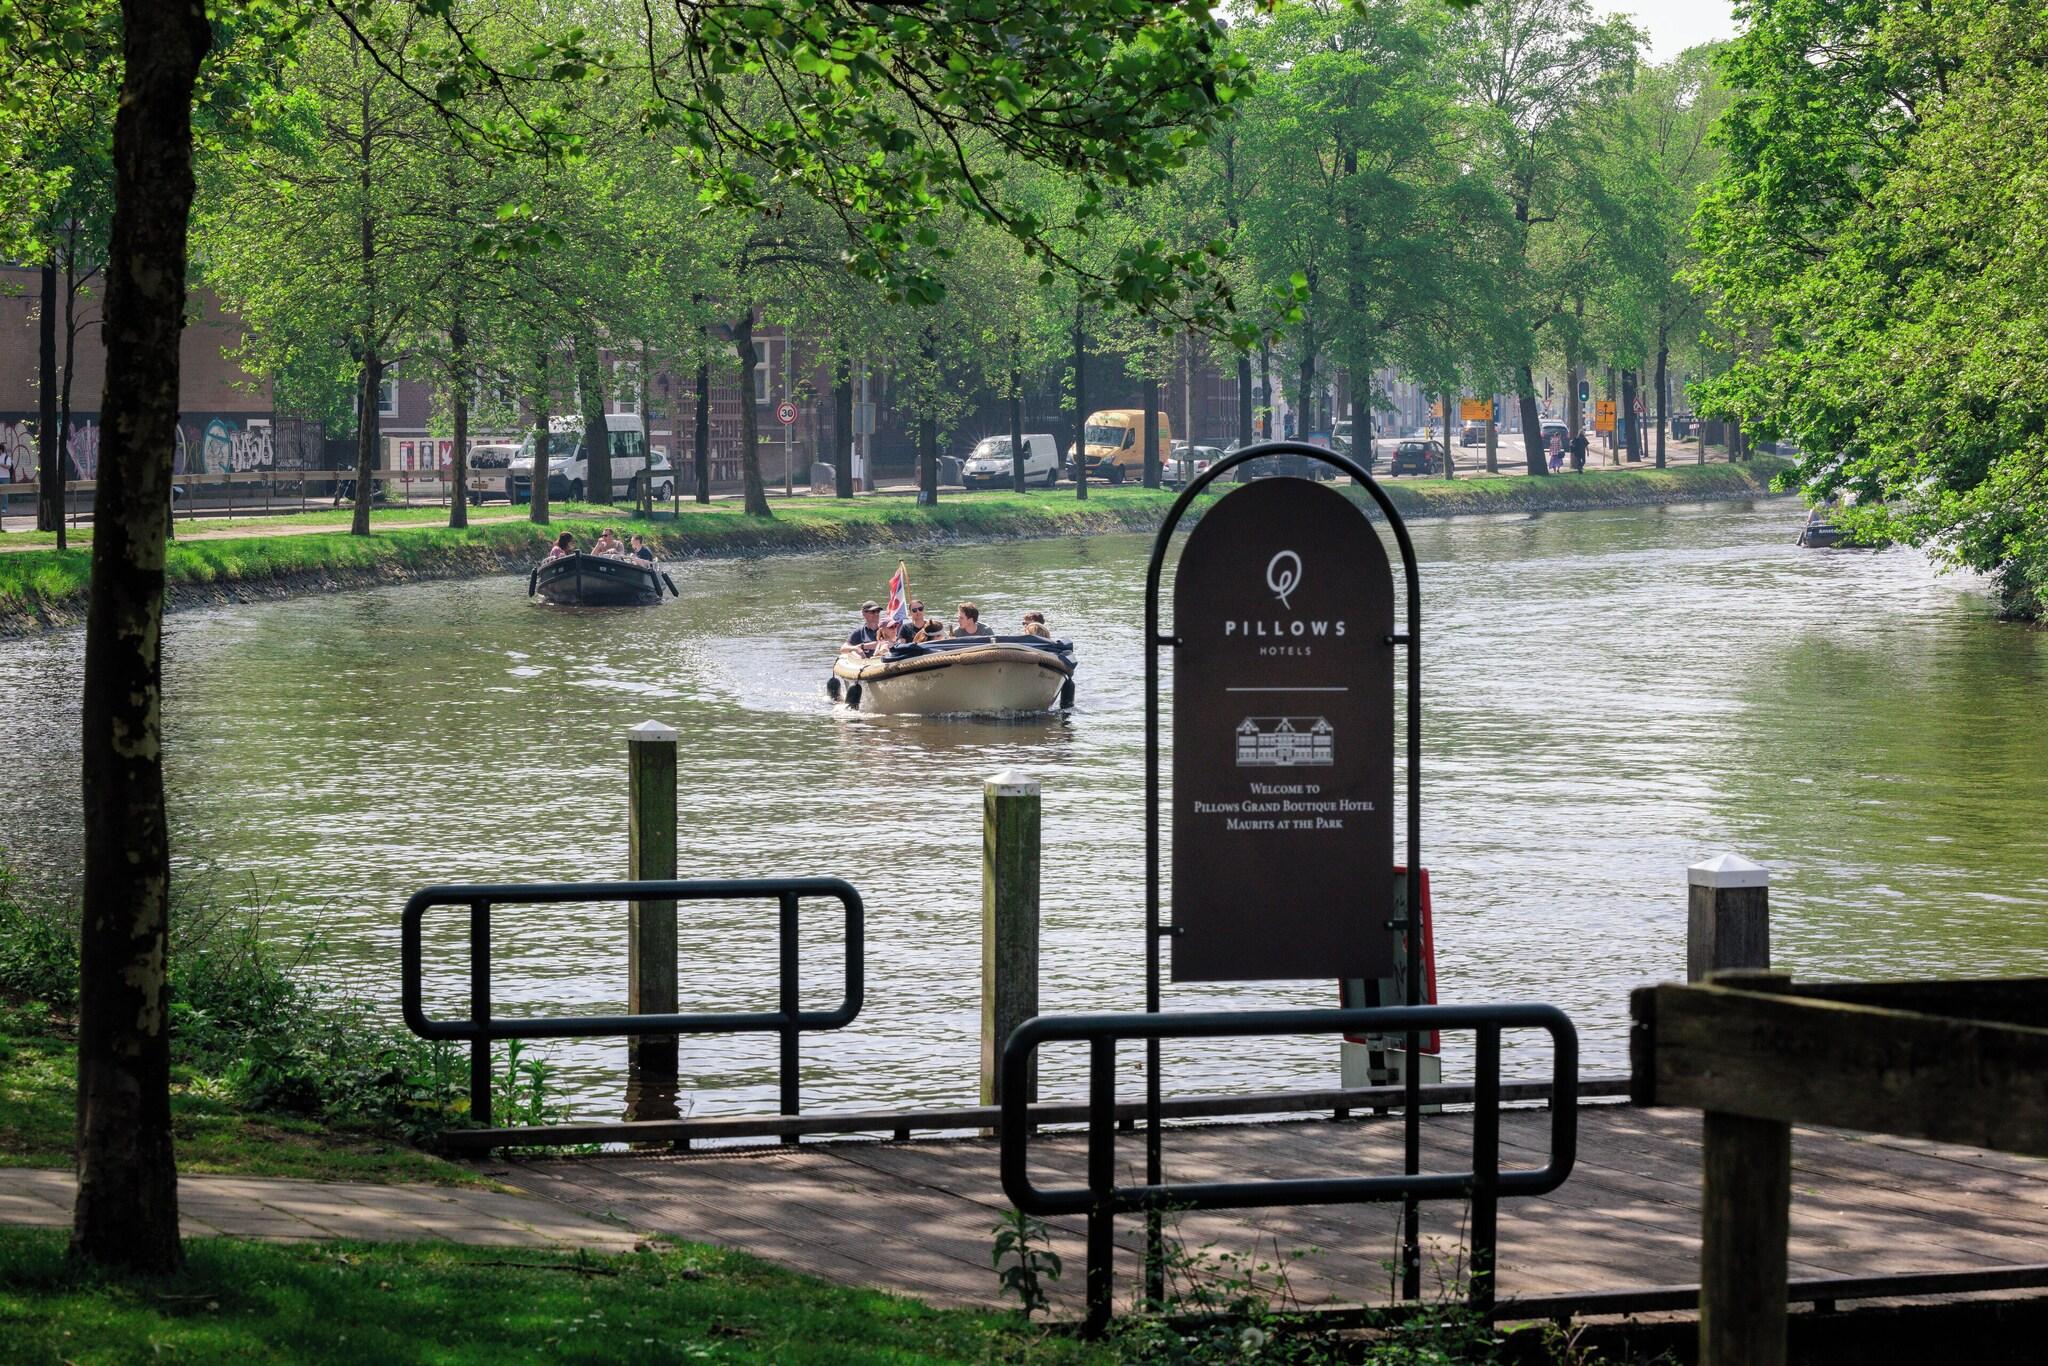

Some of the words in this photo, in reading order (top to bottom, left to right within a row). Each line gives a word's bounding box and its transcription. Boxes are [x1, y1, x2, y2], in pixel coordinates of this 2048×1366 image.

[781, 409, 793, 418] 30
[1225, 620, 1346, 636] PILLOWS
[1259, 646, 1312, 656] HOTELS
[1194, 801, 1240, 813] PILLOWS
[1241, 800, 1280, 813] GRAND
[1283, 800, 1337, 813] BOUTIQUE
[1339, 799, 1375, 811] HOTEL
[1226, 818, 1275, 830] MAURITS
[1316, 817, 1343, 829] PARK
